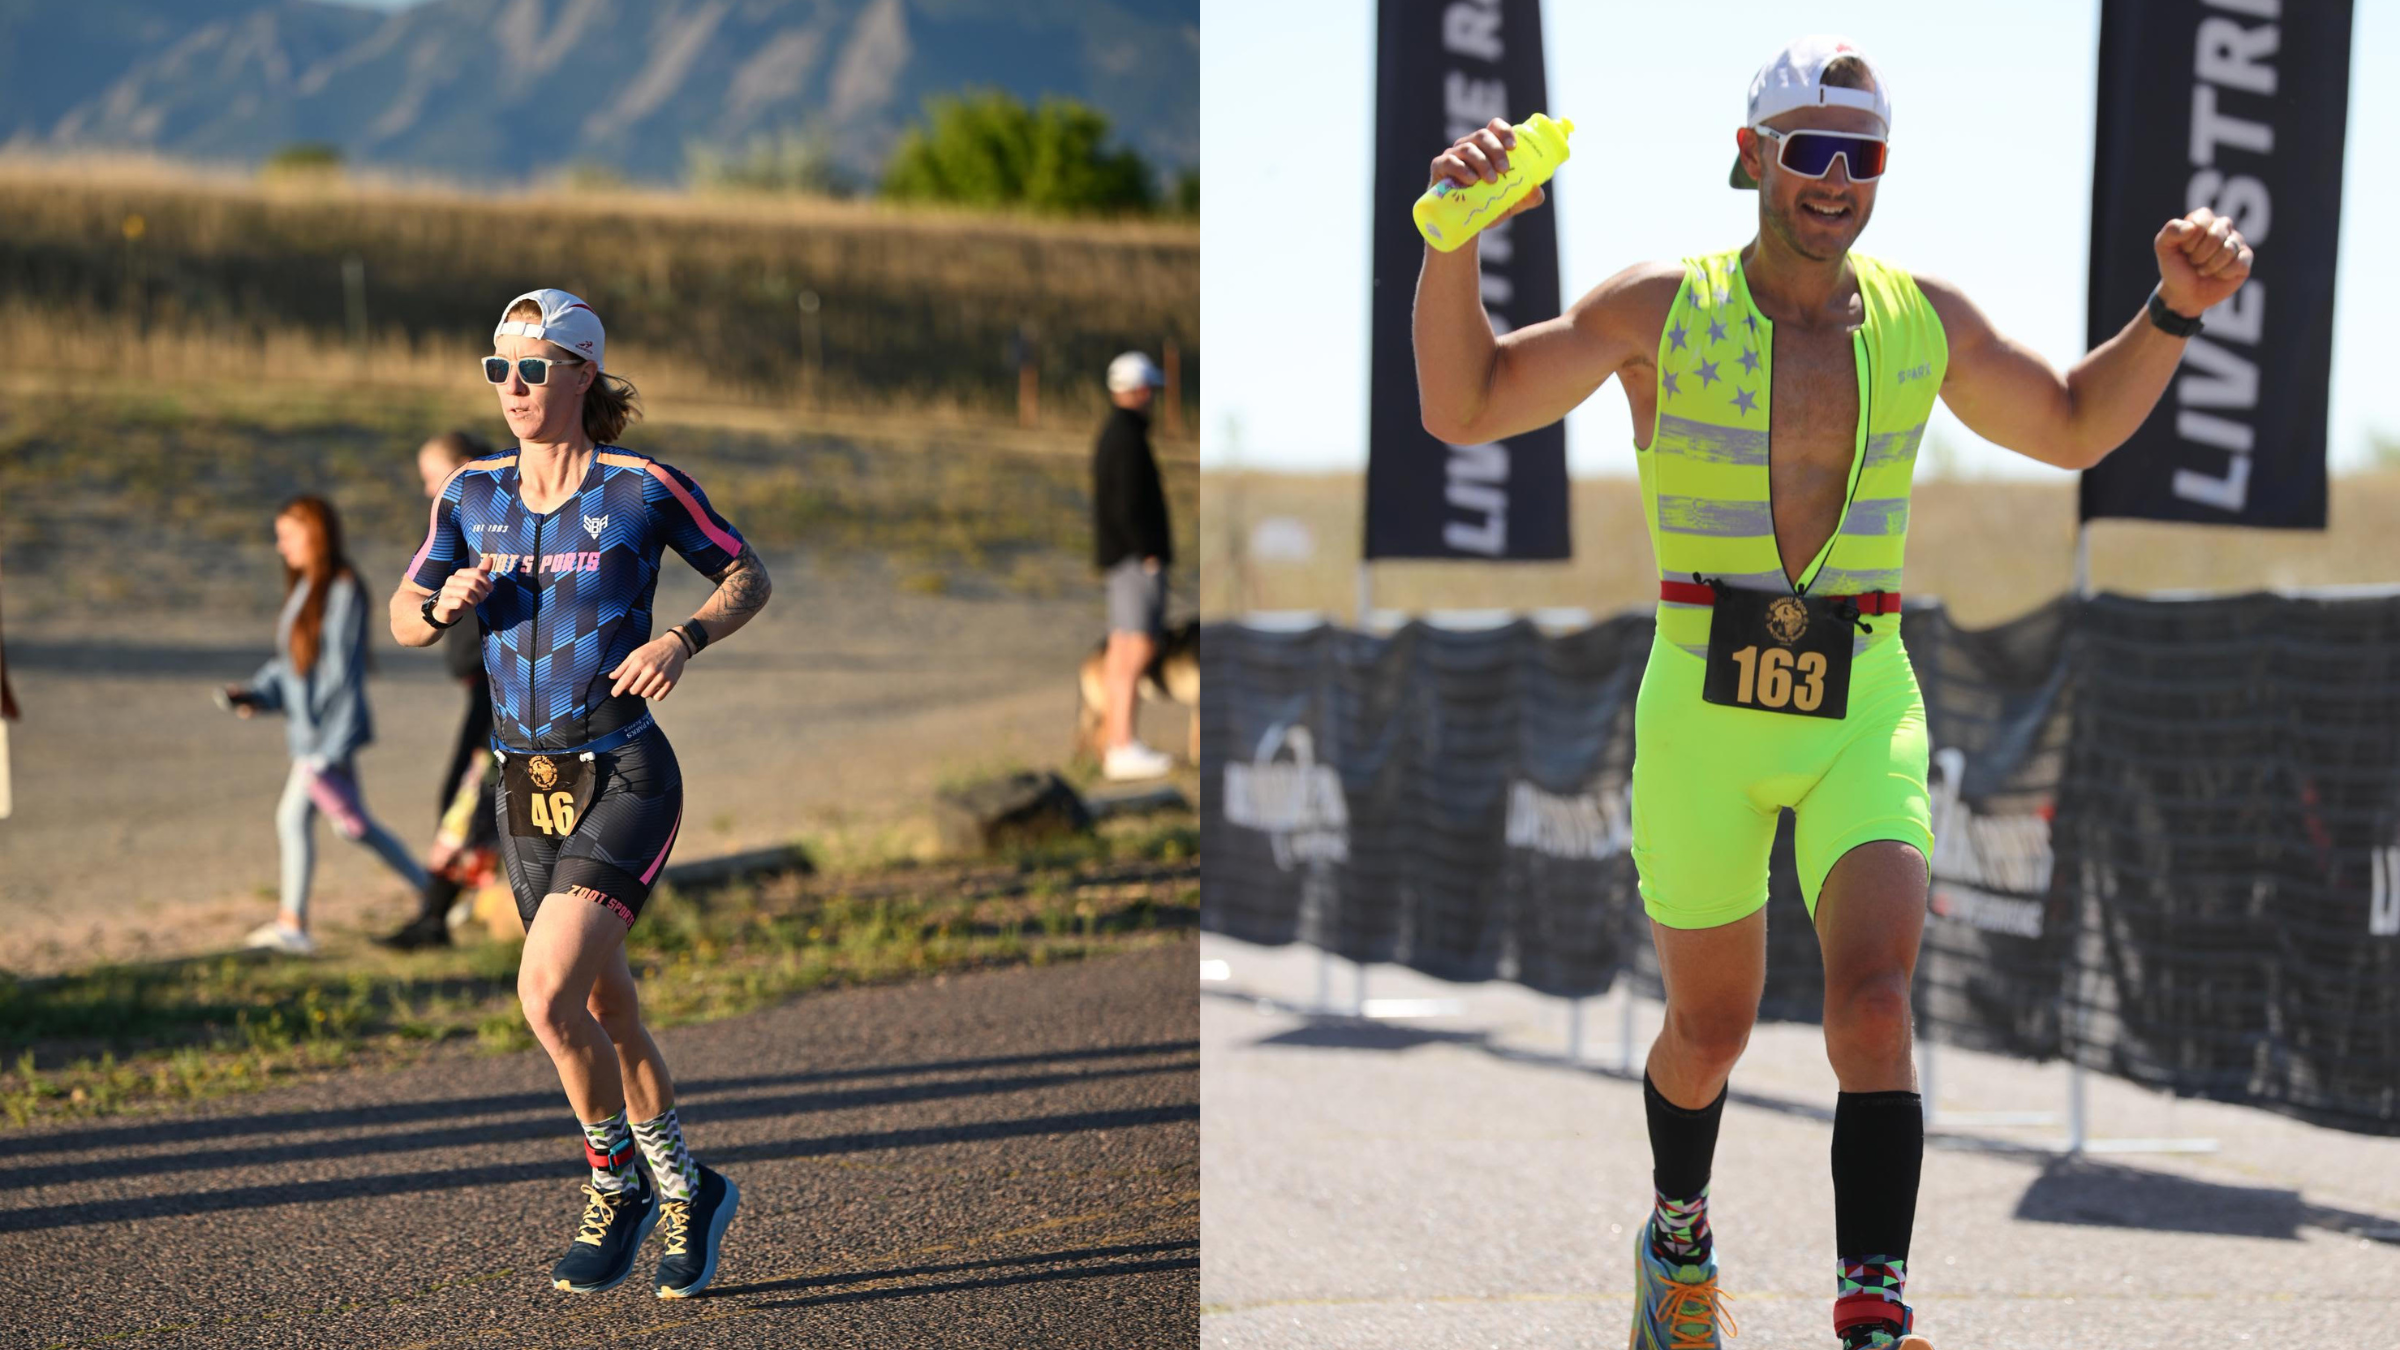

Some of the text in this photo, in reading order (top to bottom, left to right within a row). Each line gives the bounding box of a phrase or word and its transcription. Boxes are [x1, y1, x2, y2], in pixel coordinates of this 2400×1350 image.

[1443, 442, 1509, 556] LIV
[1732, 645, 1827, 712] 163
[531, 791, 574, 836] 46
[566, 884, 608, 905] ZOOT
